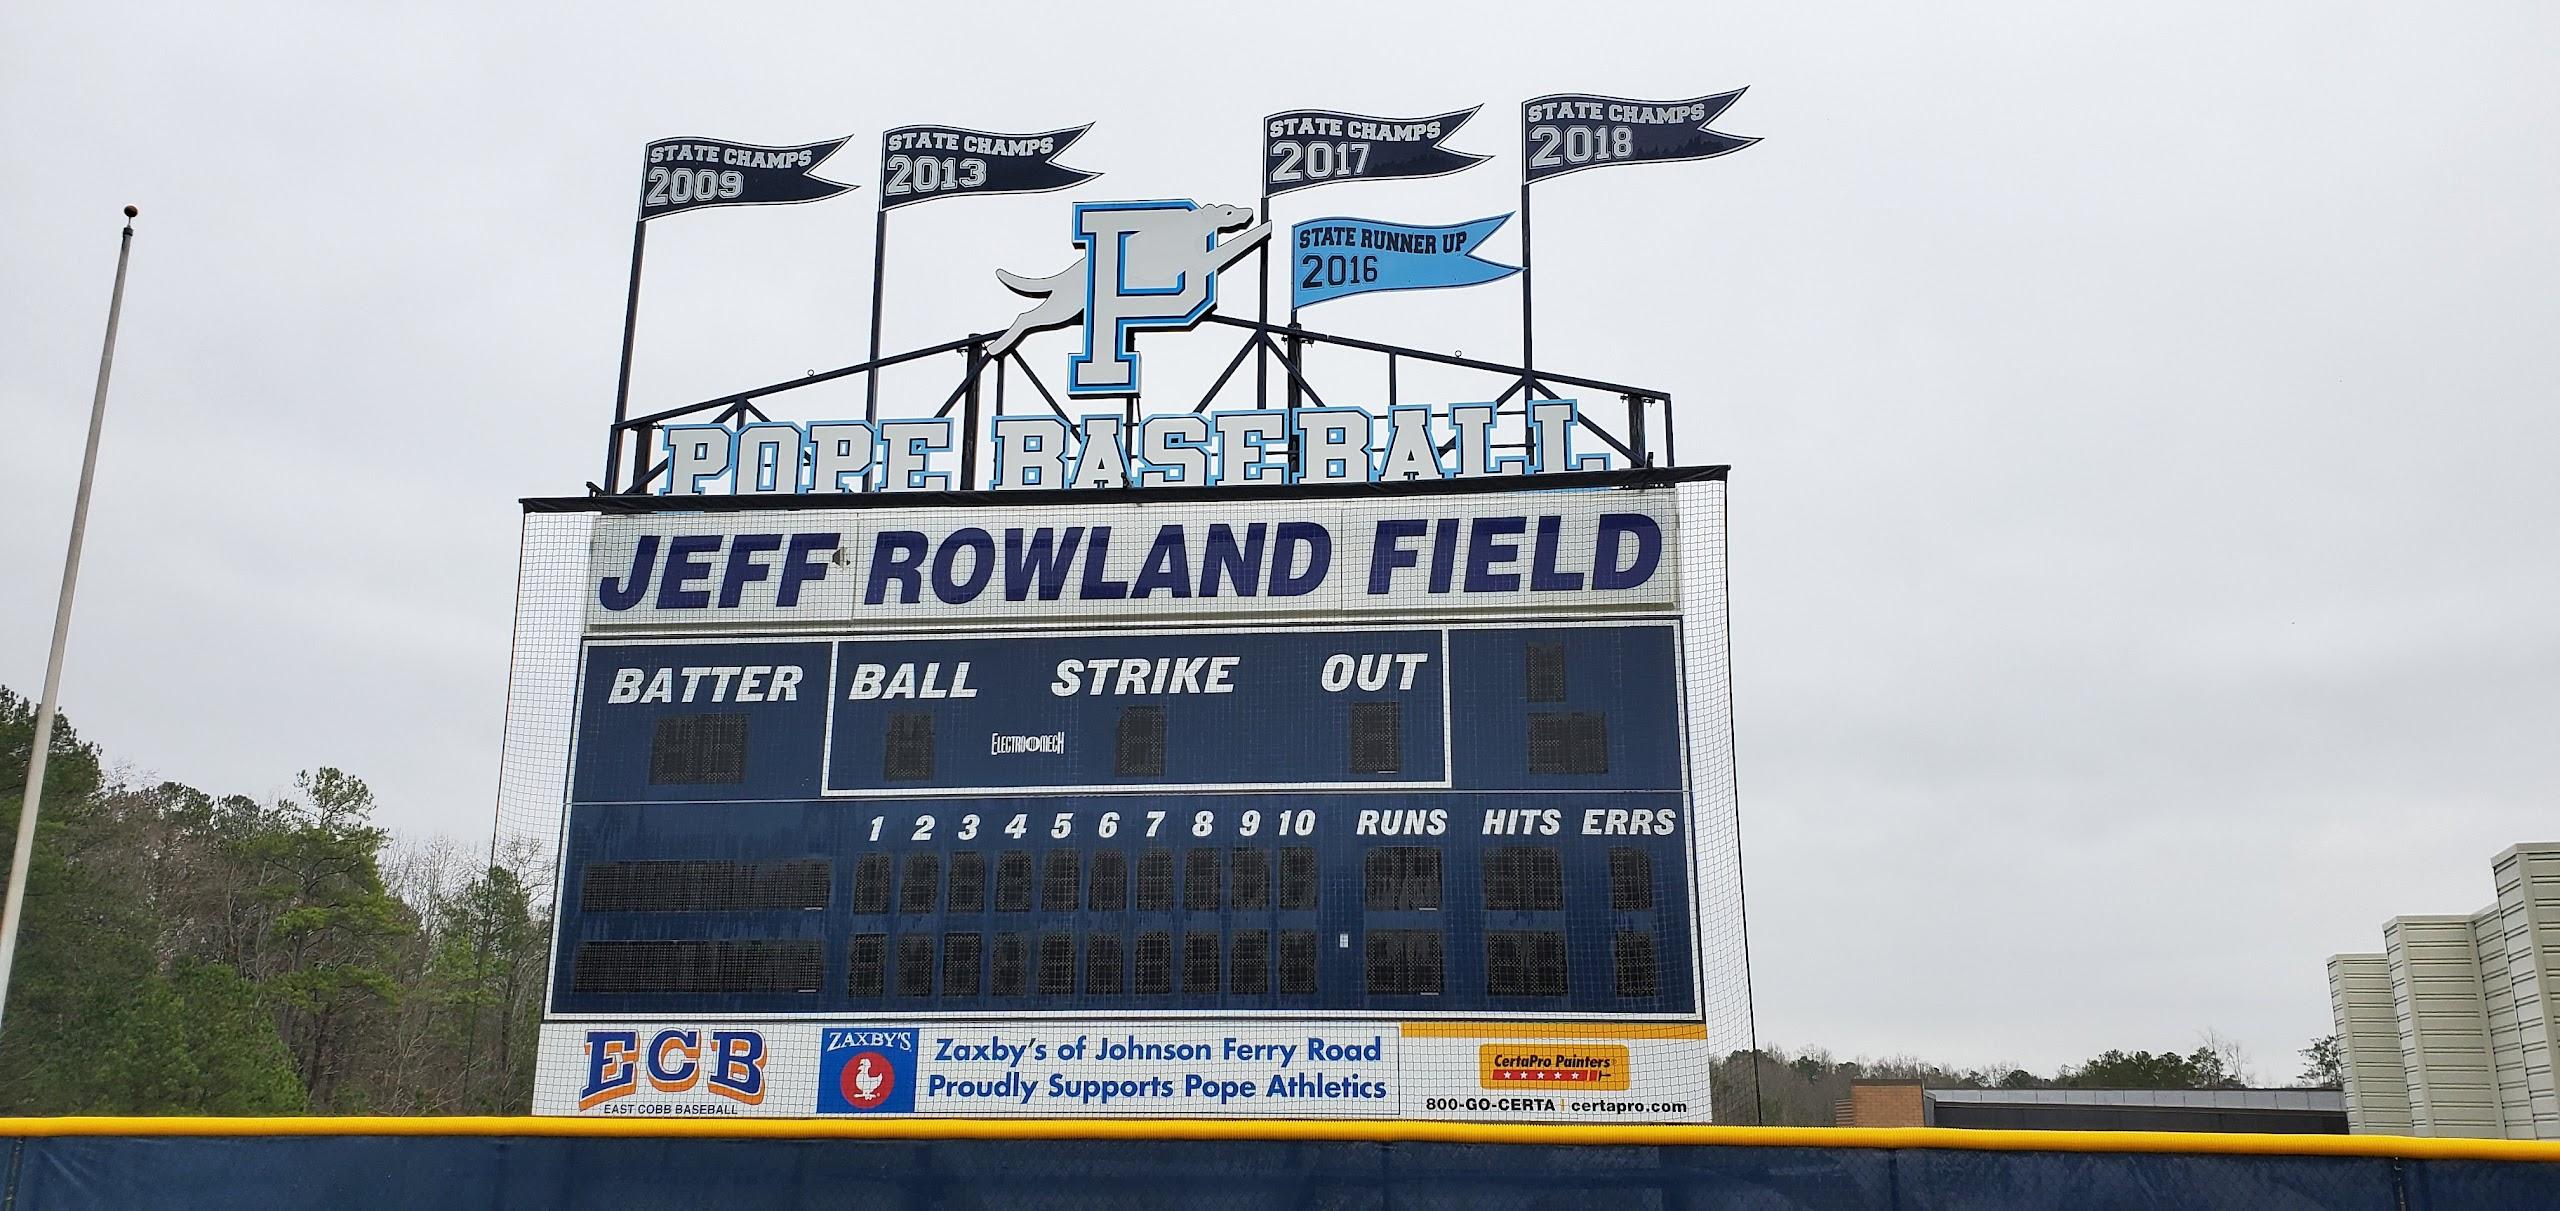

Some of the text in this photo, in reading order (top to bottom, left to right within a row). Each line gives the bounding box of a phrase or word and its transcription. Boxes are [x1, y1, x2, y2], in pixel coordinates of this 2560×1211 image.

[1528, 102, 1705, 124] STATE CHAMPS
[888, 132, 1054, 156] STATE CHAMPS
[1269, 118, 1441, 142] STATE CHAMPS
[650, 145, 812, 169] STATE CHAMPS
[1269, 141, 1371, 183] 2017
[1528, 125, 1632, 168] 2018
[646, 167, 744, 206] 2009
[885, 156, 987, 196] 2013
[1298, 227, 1467, 254] STATE RUNNER UP
[1300, 254, 1379, 289] 2016
[660, 400, 1611, 495] POPE BASEBALL
[600, 513, 1662, 611] JEFF ROWLAND FIELD
[608, 665, 804, 704] BATTER
[848, 653, 1428, 700] BALL STRIKE OUT
[869, 809, 1677, 841] 1 2 3 4 5 6 7 8 9 10 RUNS HITS ERRS
[827, 1032, 911, 1052] ZAXBY'S
[934, 1036, 1381, 1067] Zaxby's of Johnson Ferry Road
[579, 1029, 767, 1110] ECB
[1494, 1054, 1611, 1068] CertaPro Painters
[928, 1072, 1387, 1104] Proudly Supports Pope Athletics
[603, 1104, 738, 1115] EAST COBB BASEBALL
[1426, 1098, 1688, 1114] 800-GO-CERTA certapro.com
